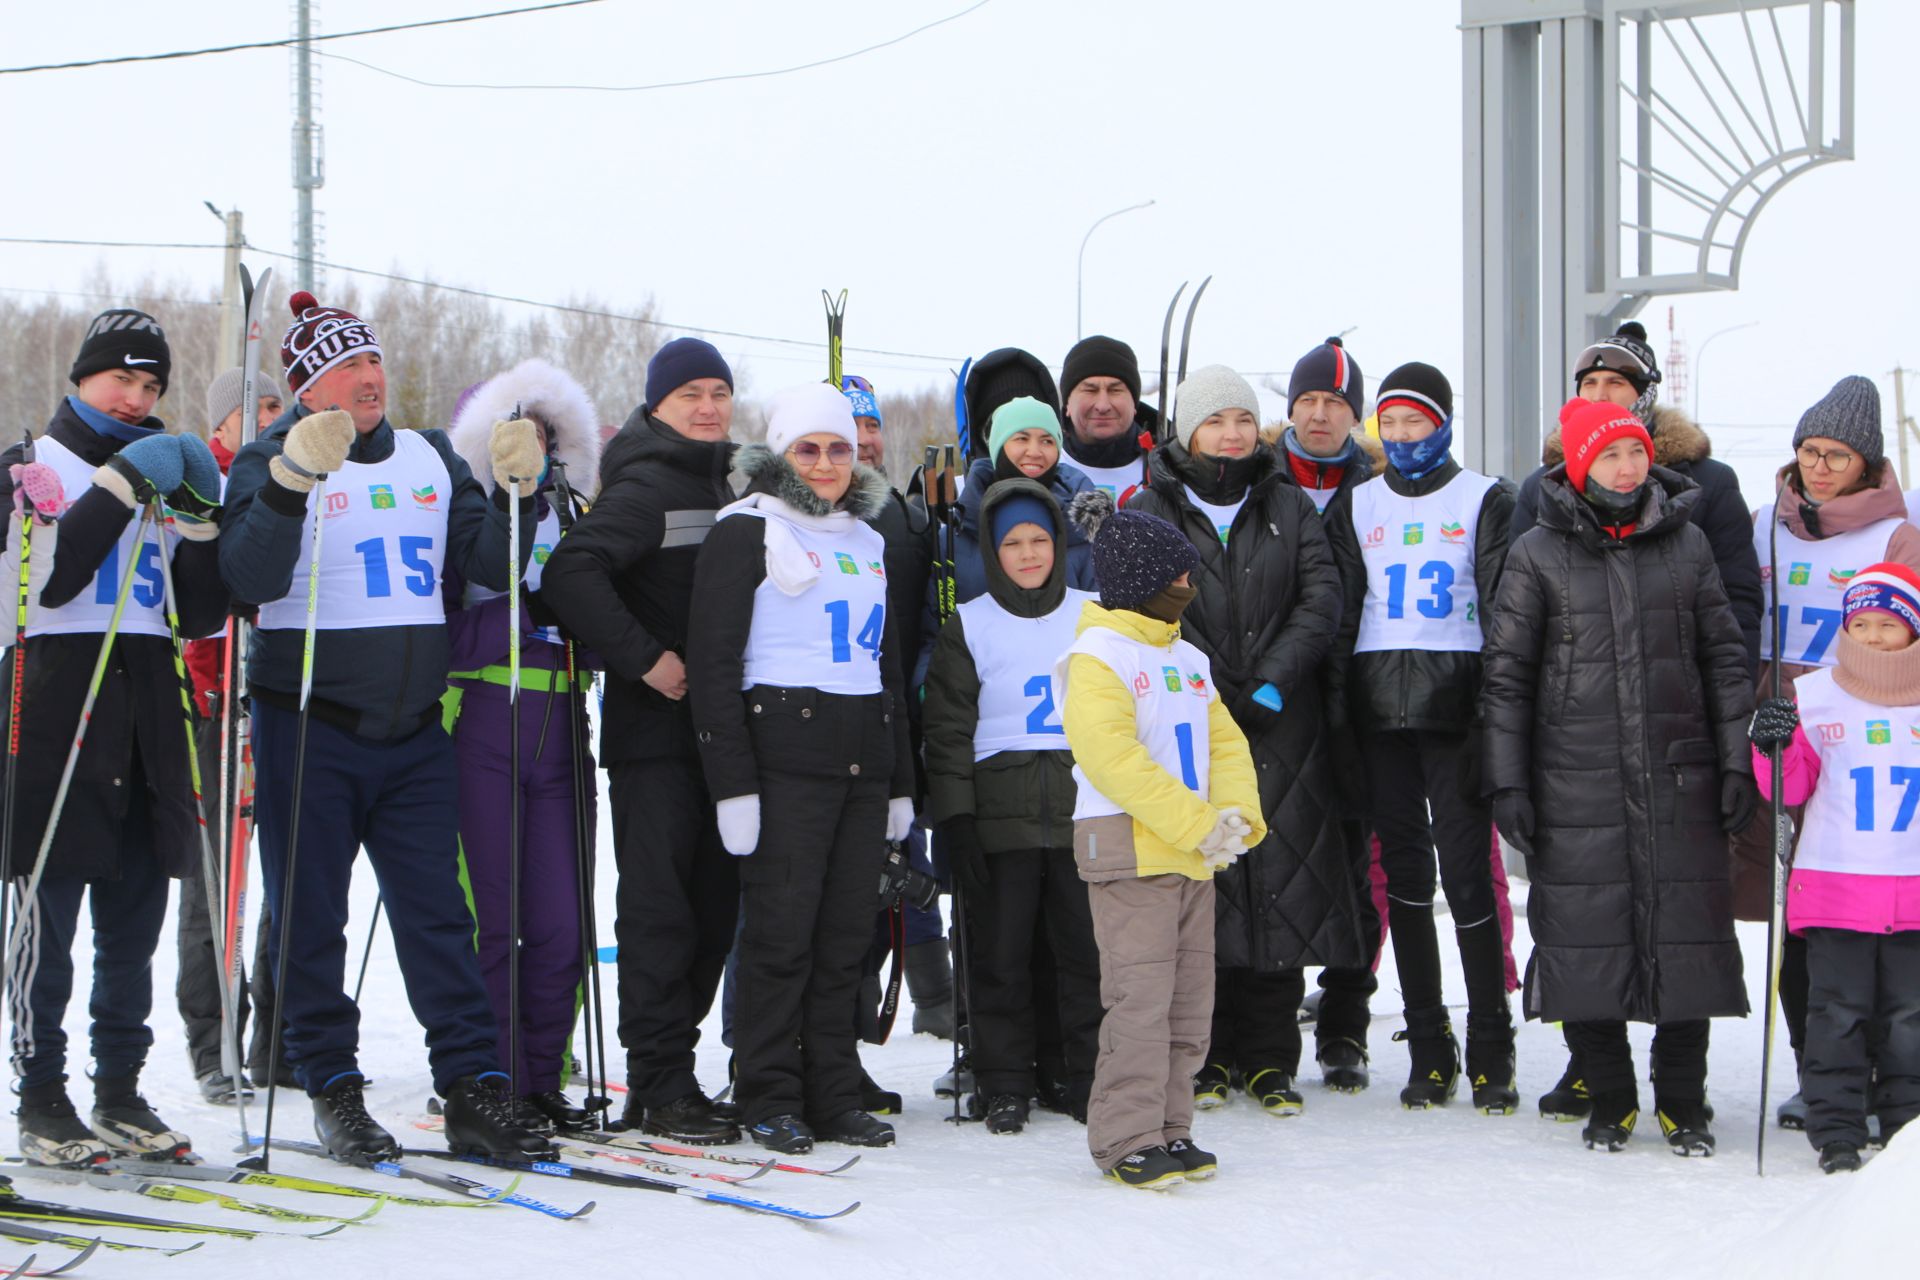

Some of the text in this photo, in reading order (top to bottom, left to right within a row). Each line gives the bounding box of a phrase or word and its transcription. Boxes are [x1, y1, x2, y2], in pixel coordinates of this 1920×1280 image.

[354, 535, 437, 598] 15
[1384, 560, 1455, 620] 13
[824, 599, 884, 664] 14
[1466, 601, 1477, 622] 2
[1769, 604, 1843, 663] 17
[1023, 674, 1066, 735] 2
[1174, 722, 1200, 792] 1
[1850, 765, 1920, 833] 17
[885, 980, 899, 1014] Canon
[532, 1161, 572, 1176] CLASSIC
